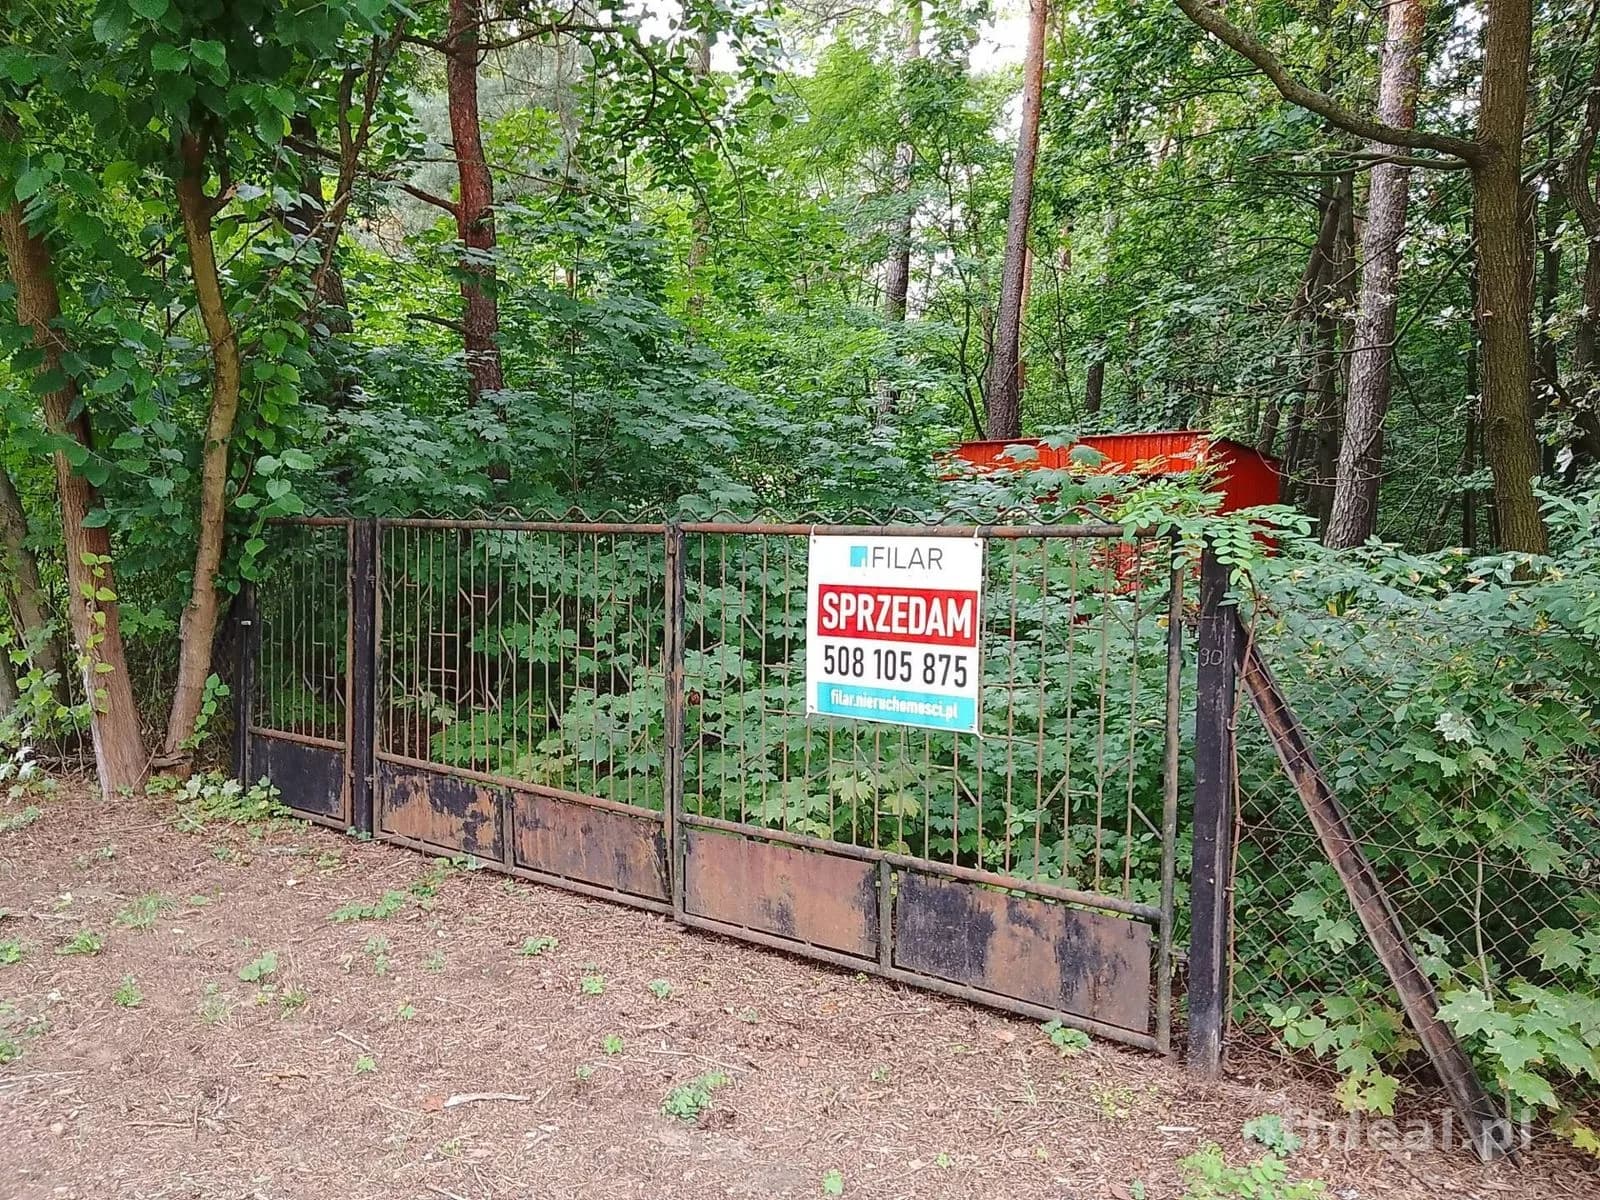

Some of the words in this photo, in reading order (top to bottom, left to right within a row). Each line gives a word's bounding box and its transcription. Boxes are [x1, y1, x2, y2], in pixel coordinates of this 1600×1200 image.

[872, 546, 944, 570] FILAR
[822, 591, 972, 639] SPRZEDAM
[824, 644, 865, 678] 508
[873, 648, 913, 683] 105
[922, 652, 968, 688] 875
[1200, 647, 1223, 667] 90
[830, 688, 959, 722] filar.nieruchomosci.pl
